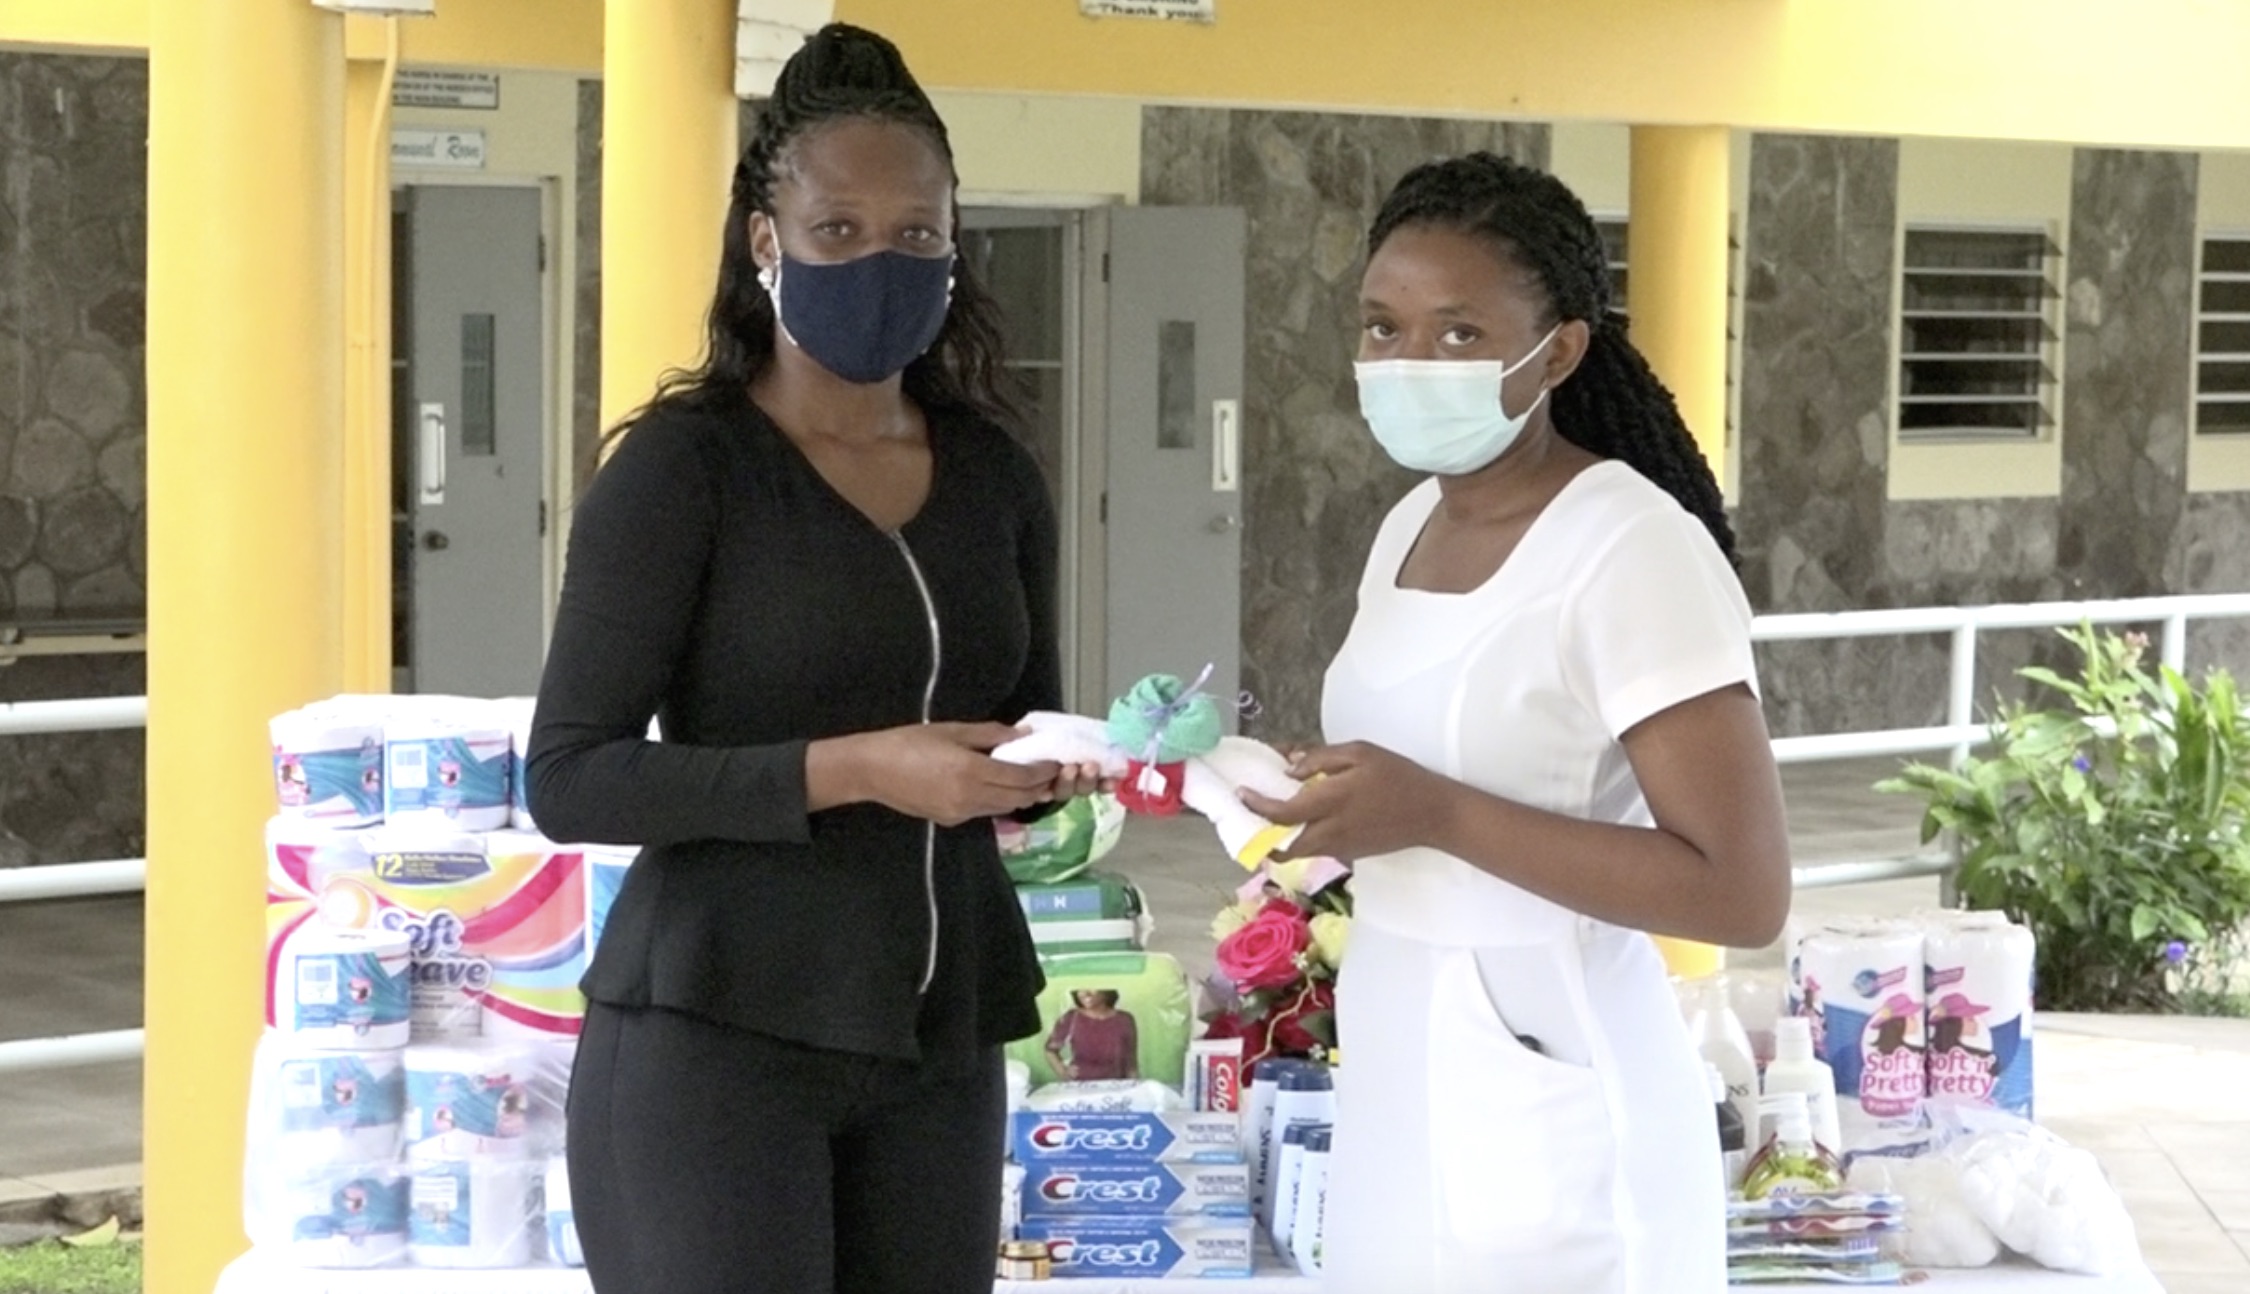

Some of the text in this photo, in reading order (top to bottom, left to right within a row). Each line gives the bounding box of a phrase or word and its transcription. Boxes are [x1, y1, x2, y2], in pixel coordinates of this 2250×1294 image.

[1100, 3, 1158, 16] Thank
[376, 853, 403, 877] 12
[1866, 1046, 1911, 1073] Soft
[1931, 1073, 1994, 1100] retty
[1029, 1121, 1152, 1153] Crest
[1040, 1173, 1162, 1203] Crest
[1048, 1236, 1161, 1266] Crest
